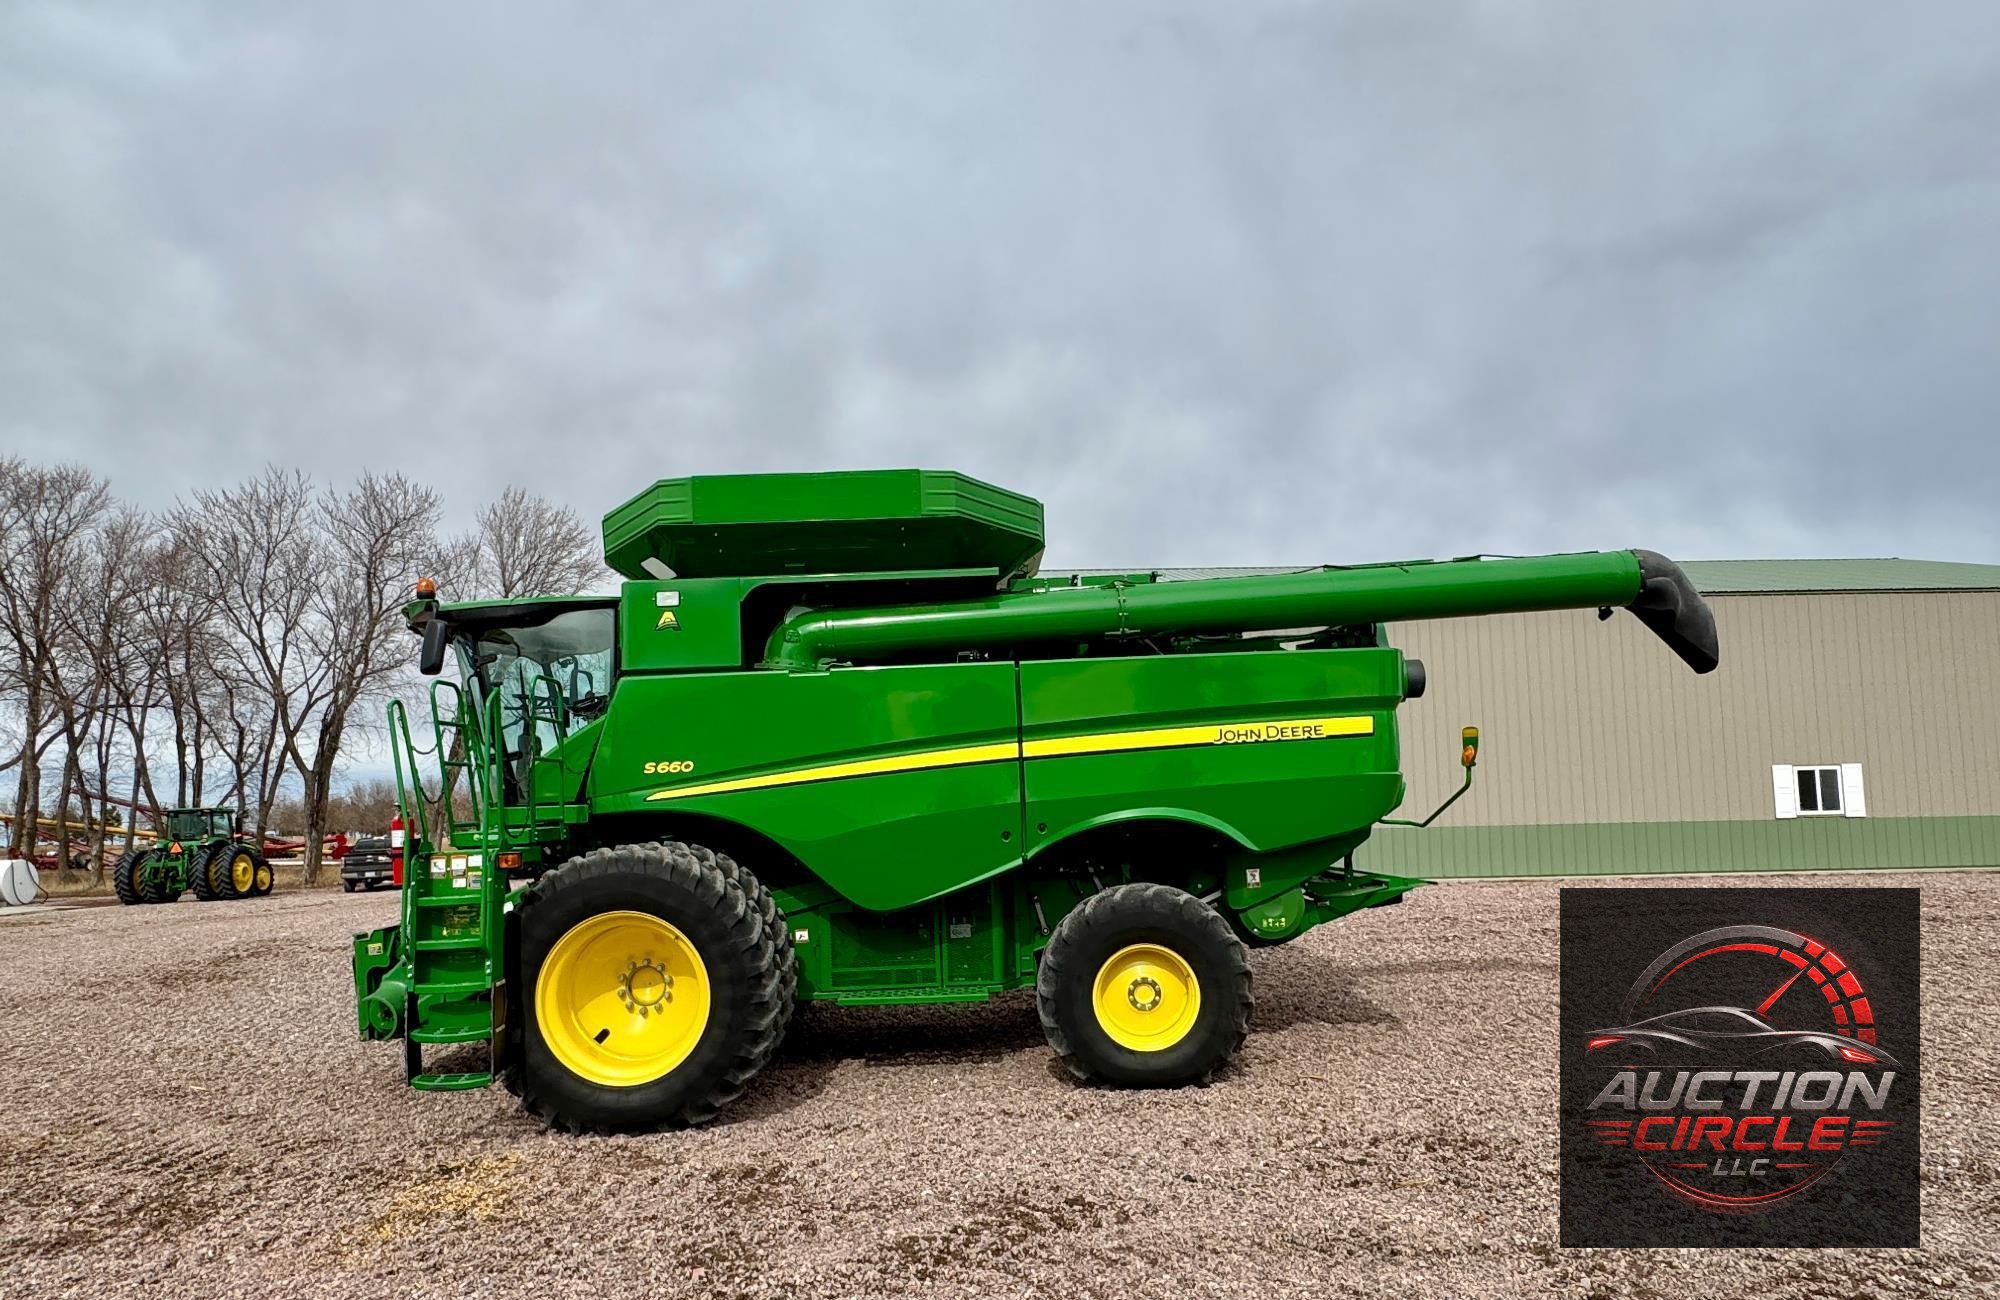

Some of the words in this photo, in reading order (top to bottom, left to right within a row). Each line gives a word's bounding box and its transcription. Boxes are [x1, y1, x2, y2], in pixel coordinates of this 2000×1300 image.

[1214, 728, 1262, 742] JOHN
[1266, 725, 1325, 739] DEERE
[643, 760, 694, 774] S660
